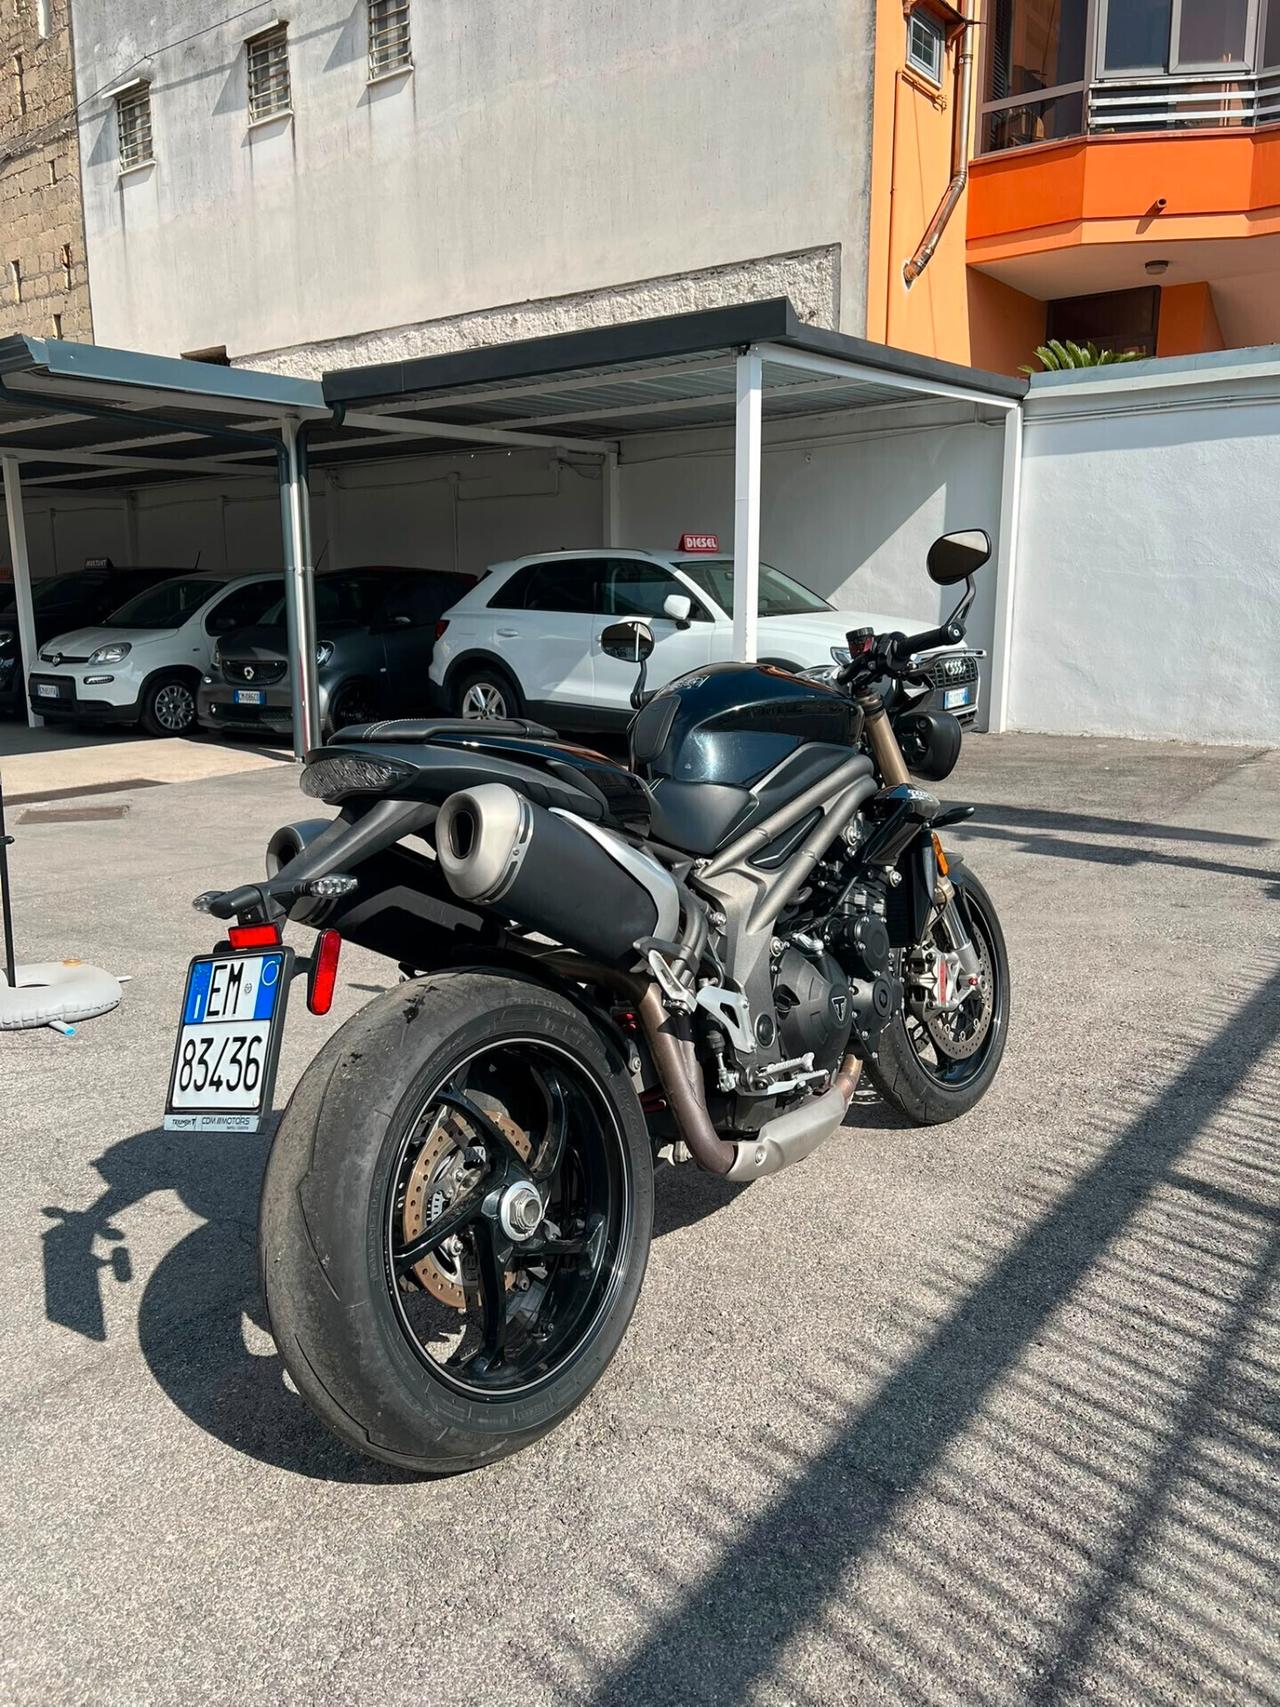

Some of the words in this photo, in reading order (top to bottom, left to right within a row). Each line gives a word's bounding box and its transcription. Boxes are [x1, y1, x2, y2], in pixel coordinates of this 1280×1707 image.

[686, 537, 717, 548] DIESEL
[206, 962, 244, 1017] EM
[179, 1035, 263, 1092] 83436
